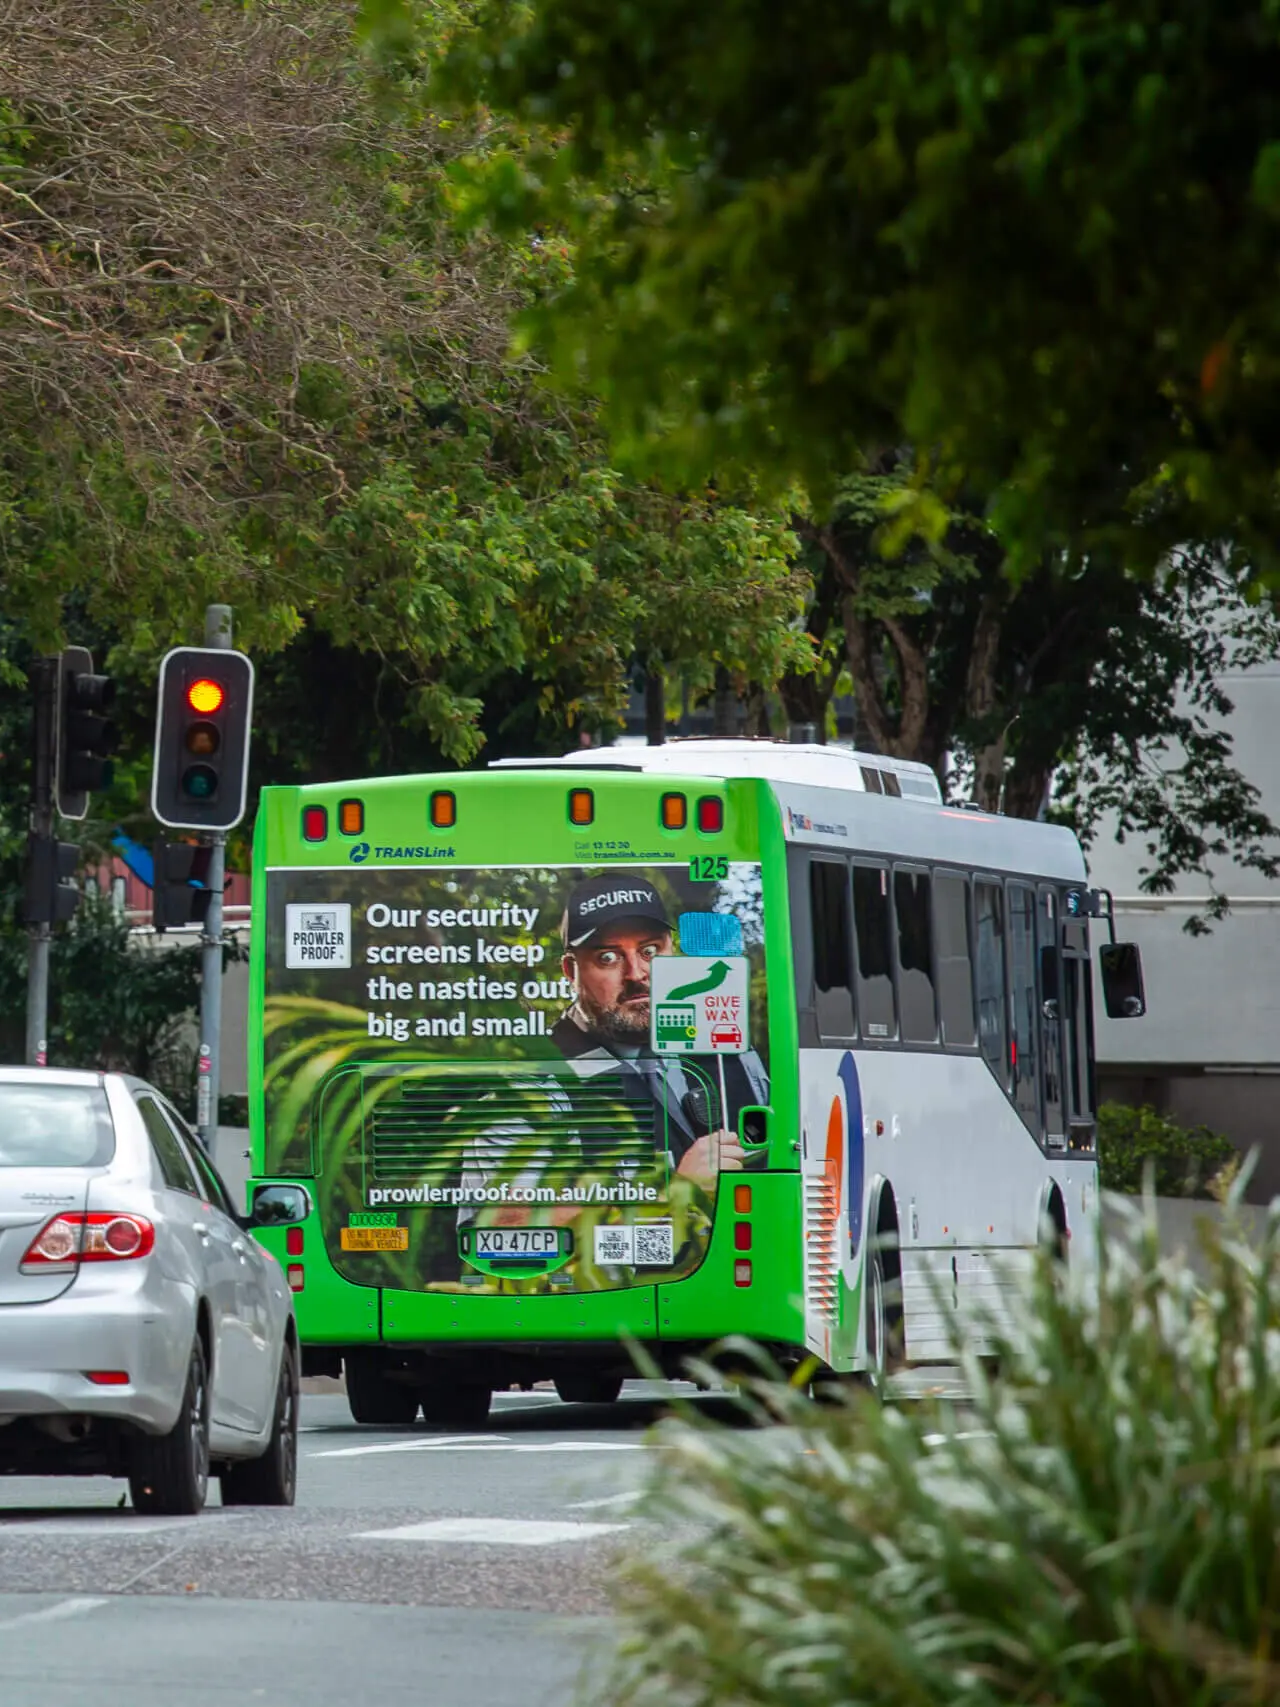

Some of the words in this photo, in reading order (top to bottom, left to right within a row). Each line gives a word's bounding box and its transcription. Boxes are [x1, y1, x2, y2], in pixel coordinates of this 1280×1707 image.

[689, 856, 729, 880] 125
[579, 890, 653, 916] SECURITY
[366, 903, 422, 928] Our
[426, 902, 539, 931] security
[293, 931, 345, 946] PROWLER
[301, 946, 337, 960] PROOF
[366, 944, 471, 964] screens
[477, 938, 545, 967] keep
[366, 976, 413, 1000] the
[419, 975, 517, 1000] nasties
[522, 977, 579, 1002] out,
[704, 996, 741, 1008] GIVE
[367, 1012, 410, 1042] big
[415, 1011, 466, 1036] and
[471, 1011, 553, 1036] small.
[705, 1010, 739, 1022] WAY
[369, 1183, 658, 1206] prowlerproof.com.au/bribie
